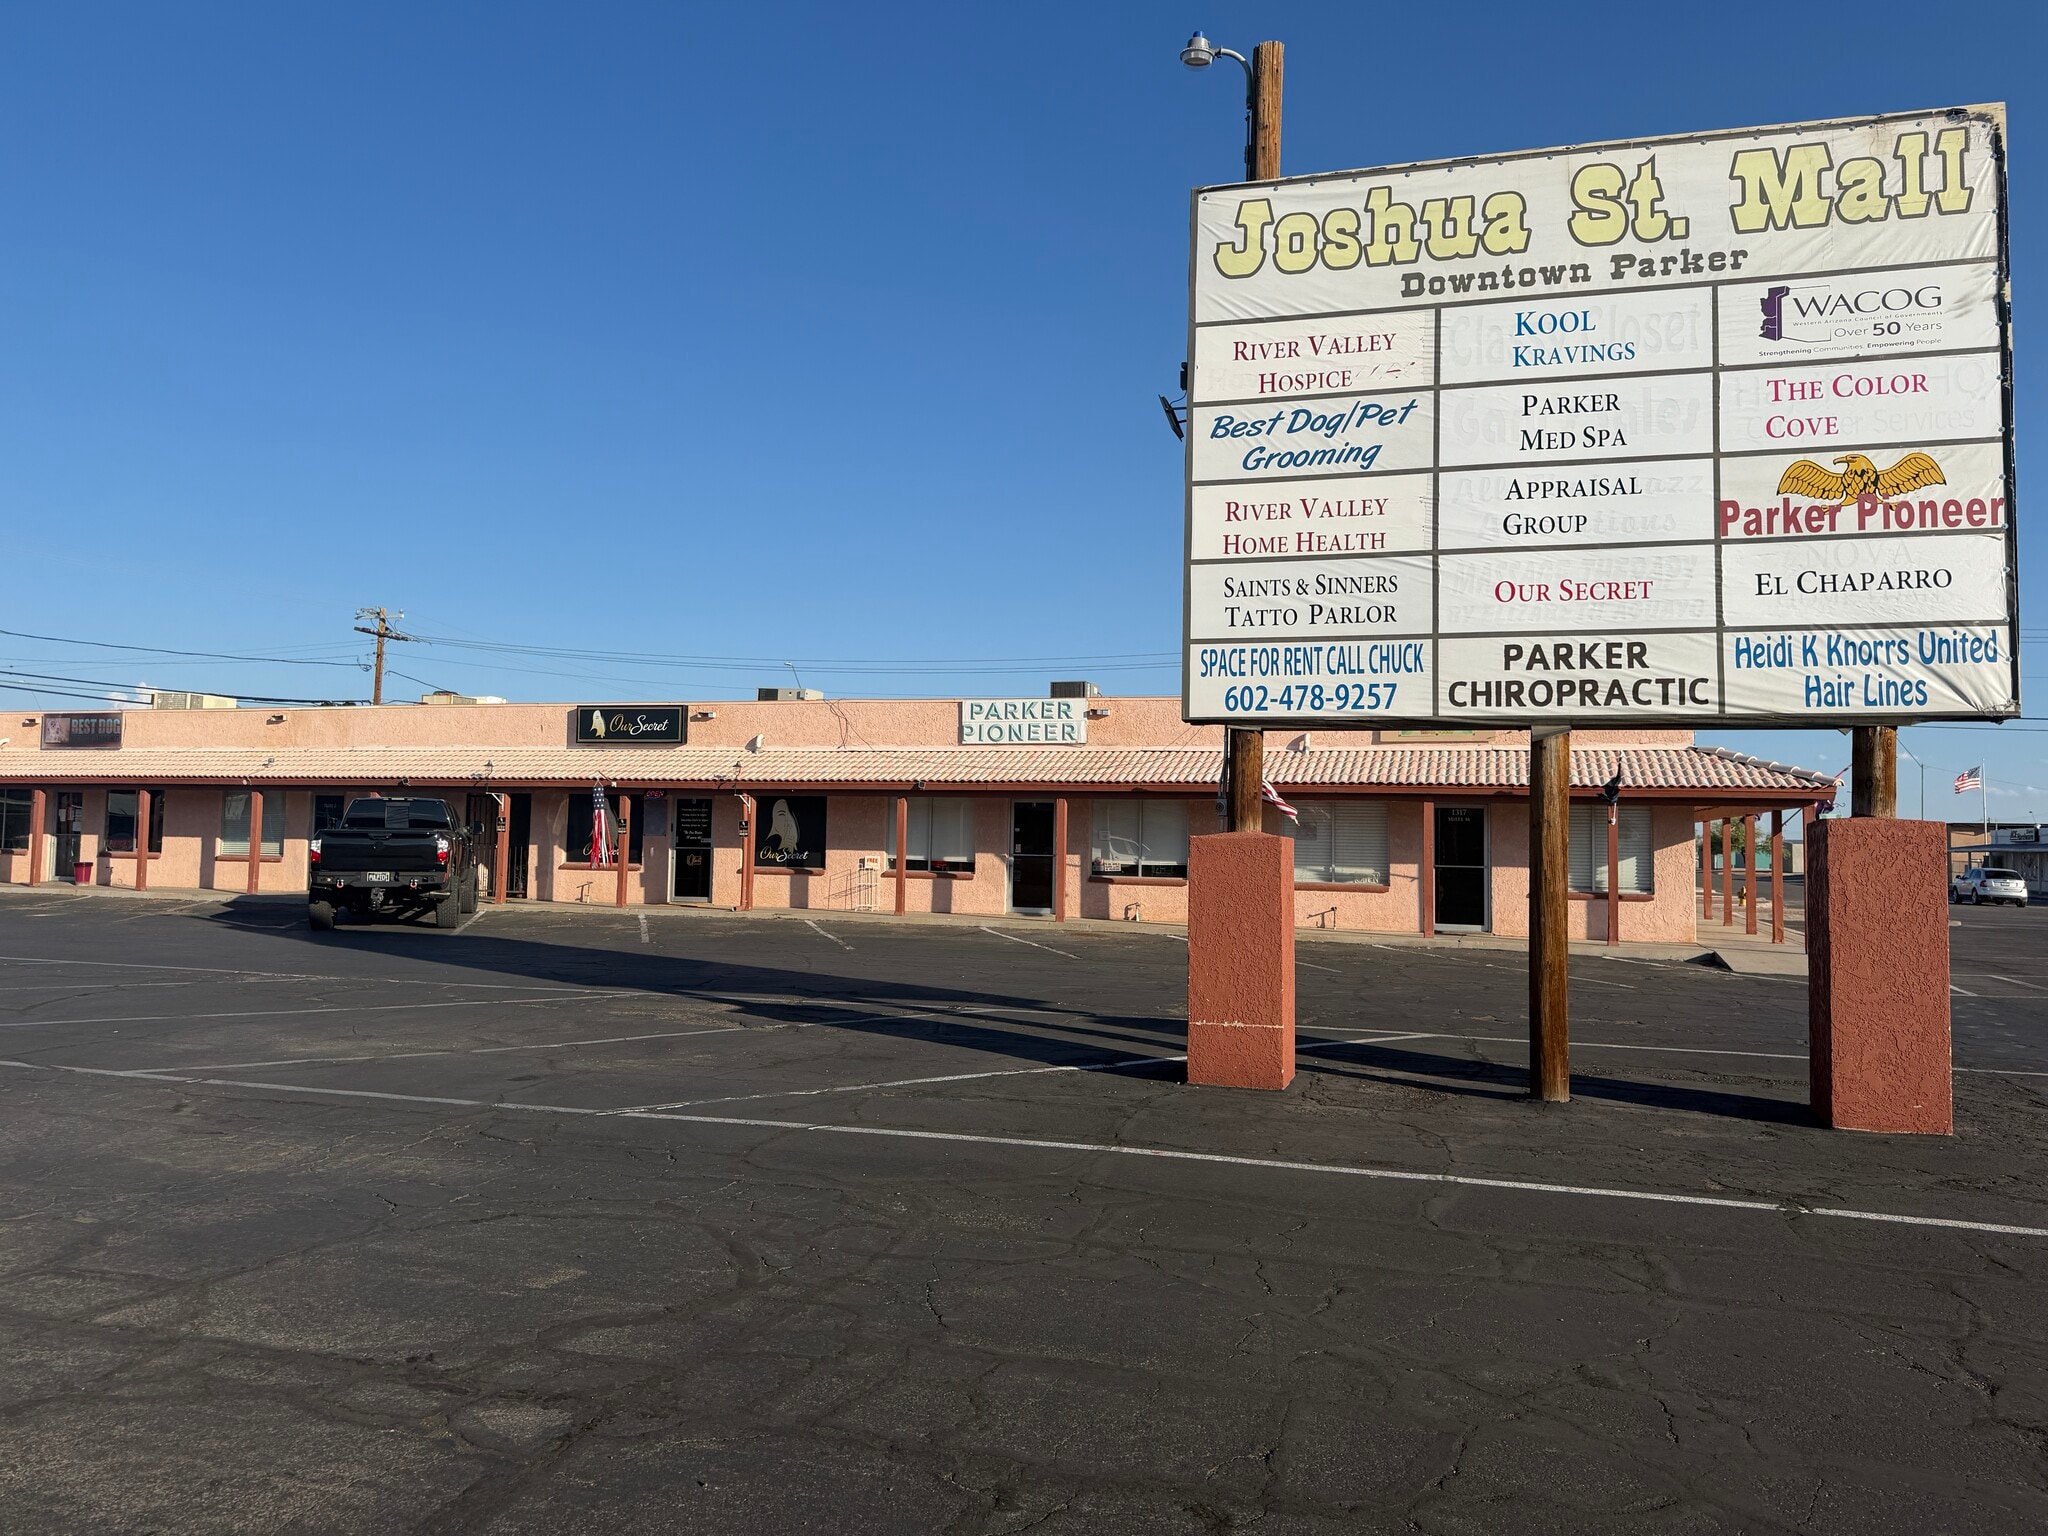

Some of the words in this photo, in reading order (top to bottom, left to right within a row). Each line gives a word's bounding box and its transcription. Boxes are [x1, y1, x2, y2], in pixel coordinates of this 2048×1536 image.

[1213, 186, 1532, 279] Joshua
[1567, 154, 1689, 247] St.
[1729, 127, 1975, 234] Mall
[1400, 262, 1592, 298] Downtown
[1610, 248, 1749, 280] Parker
[1792, 286, 1942, 318] WACOG
[1514, 310, 1596, 337] KOOL
[1895, 311, 1943, 319] Governments
[1834, 327, 1868, 338] Over
[1872, 321, 1901, 337] 50
[1905, 321, 1943, 332] Years
[1232, 341, 1300, 361] RIVER
[1307, 333, 1397, 355] VALLEY
[1513, 342, 1636, 368] KRAVINGS
[1758, 347, 1812, 357] Strengthening
[1867, 338, 1915, 349] Empowering
[1916, 338, 1942, 346] People
[1258, 370, 1353, 394] HOSPICE
[1766, 379, 1824, 402] THE
[1832, 374, 1929, 398] COLOR
[1522, 393, 1620, 416] PARKER
[1210, 411, 1285, 439] Best
[1286, 399, 1418, 439] Dog/Pet
[1765, 415, 1839, 438] COVE
[1519, 429, 1576, 451] MED
[1582, 426, 1627, 449] SPA
[1242, 442, 1383, 470] Grooming
[1504, 477, 1643, 500] APPRAISAL
[1224, 501, 1292, 522] RIVER
[1299, 498, 1389, 518] VALLEY
[1719, 497, 1842, 537] Parker
[1857, 493, 2005, 531] Pioneer
[1503, 513, 1587, 535] GROUP
[1222, 534, 1289, 555] HOME
[1295, 532, 1386, 552] HEALTH
[1223, 577, 1291, 598] SAINTS
[1296, 579, 1310, 596] &
[1315, 574, 1398, 595] SINNERS
[1494, 580, 1551, 603] OUR
[1559, 578, 1654, 601] SECRET
[1755, 573, 1788, 596] EL
[1796, 568, 1953, 595] CHAPARRO
[1224, 606, 1298, 627] TATTO
[1309, 604, 1397, 625] PARLOR
[1200, 648, 1246, 677] SPACE
[1250, 647, 1280, 676] FOR
[1284, 646, 1323, 676] RENT
[1326, 645, 1365, 675] CALL
[1369, 643, 1424, 673] CHUCK
[1503, 641, 1650, 671] PARKER
[1735, 635, 1793, 669] Heidi
[1802, 635, 1819, 667] K
[1827, 633, 1910, 667] Knorrs
[1918, 629, 1998, 665] United
[1224, 683, 1398, 712] 602-478-9257
[1448, 677, 1710, 708] CHIROPRACTIC
[1804, 674, 1855, 708] Hair
[1863, 673, 1928, 707] Lines
[970, 701, 1073, 720] PARKER
[71, 718, 97, 735] BEST
[98, 718, 120, 734] DOG
[609, 713, 632, 733] Our
[629, 714, 669, 736] Secret
[962, 723, 1077, 742] PIONEER
[1452, 808, 1467, 816] 1317
[760, 846, 779, 860] Our
[776, 847, 809, 863] Secret
